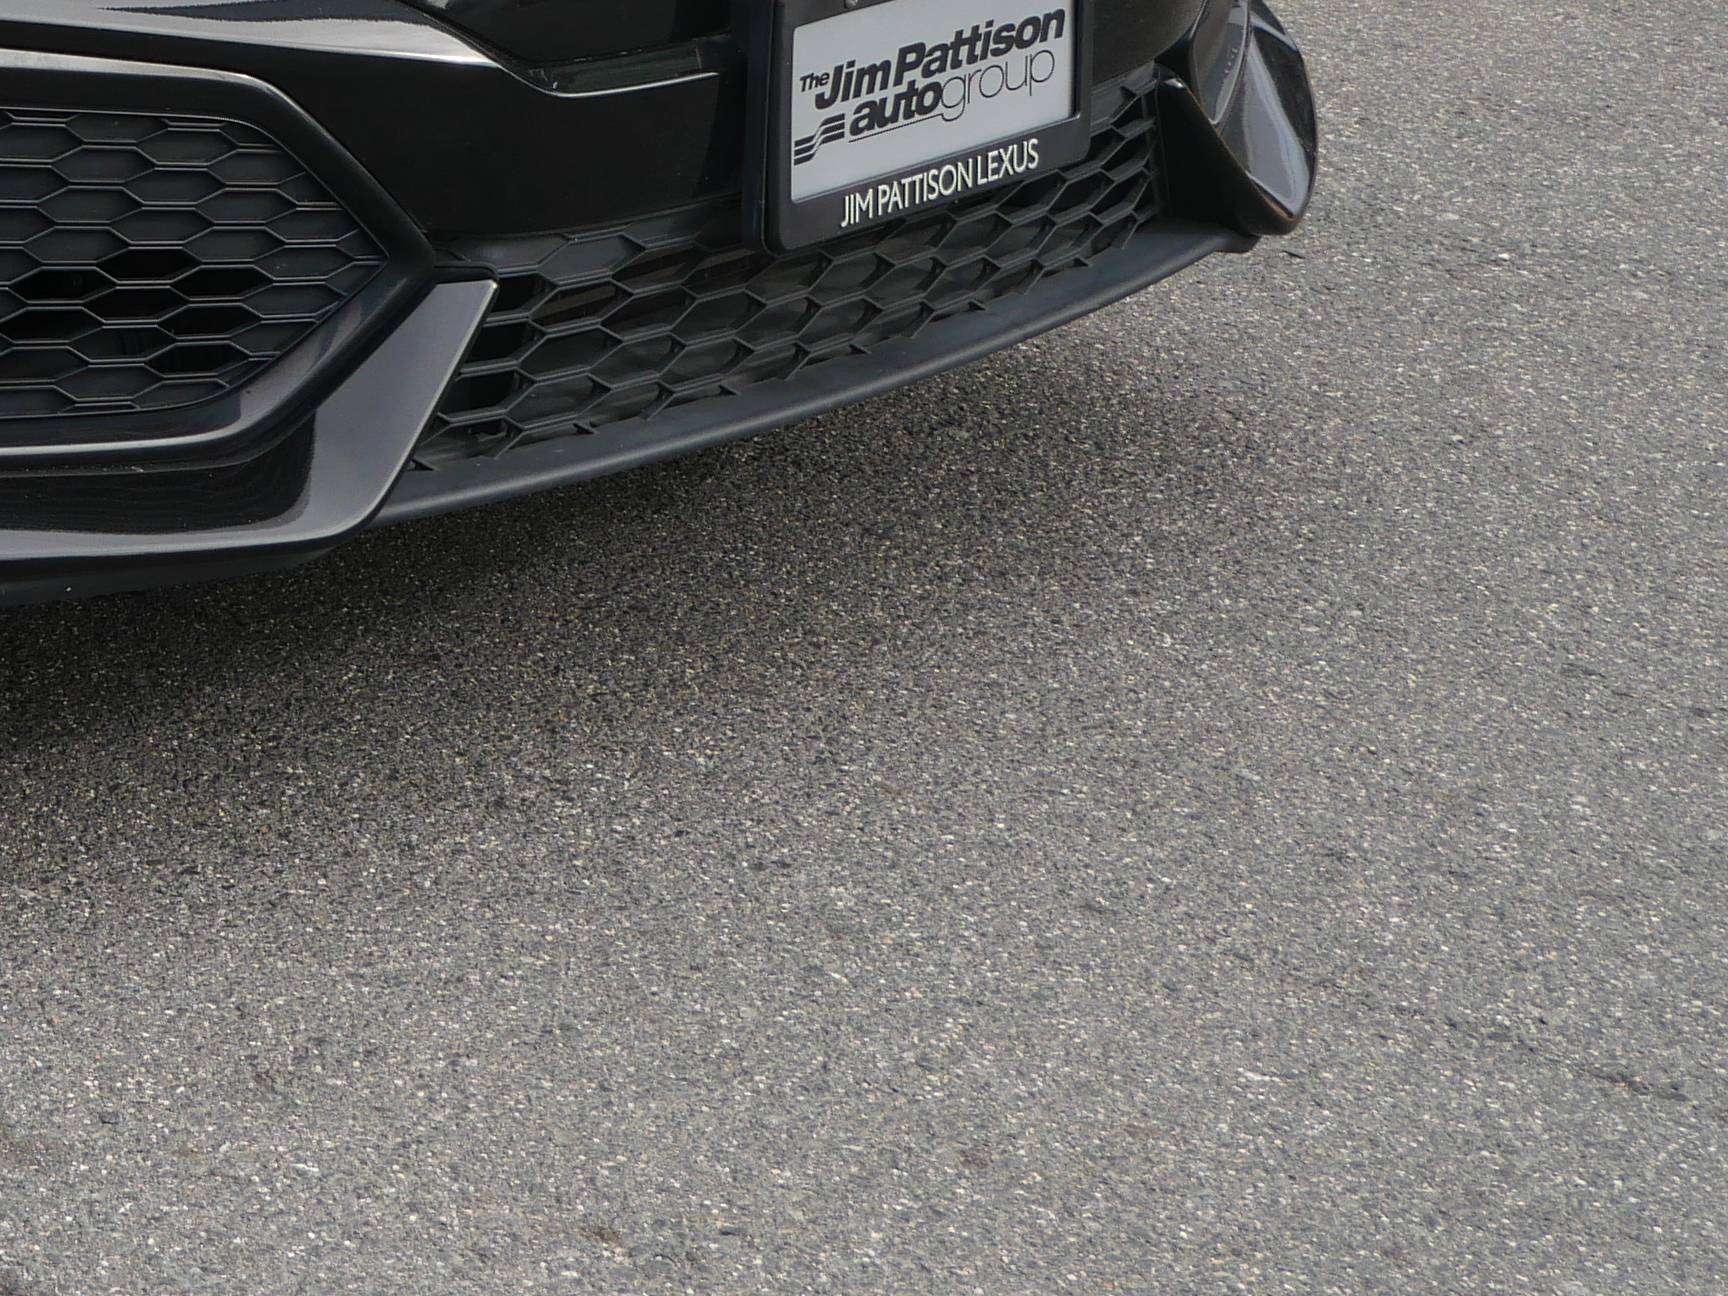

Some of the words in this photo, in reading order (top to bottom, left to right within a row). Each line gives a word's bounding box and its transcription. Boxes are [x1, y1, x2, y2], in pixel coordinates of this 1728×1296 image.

[800, 72, 830, 92] The
[840, 188, 874, 227] JIM
[877, 160, 973, 217] PATTISON
[977, 138, 1039, 186] LEXUS
